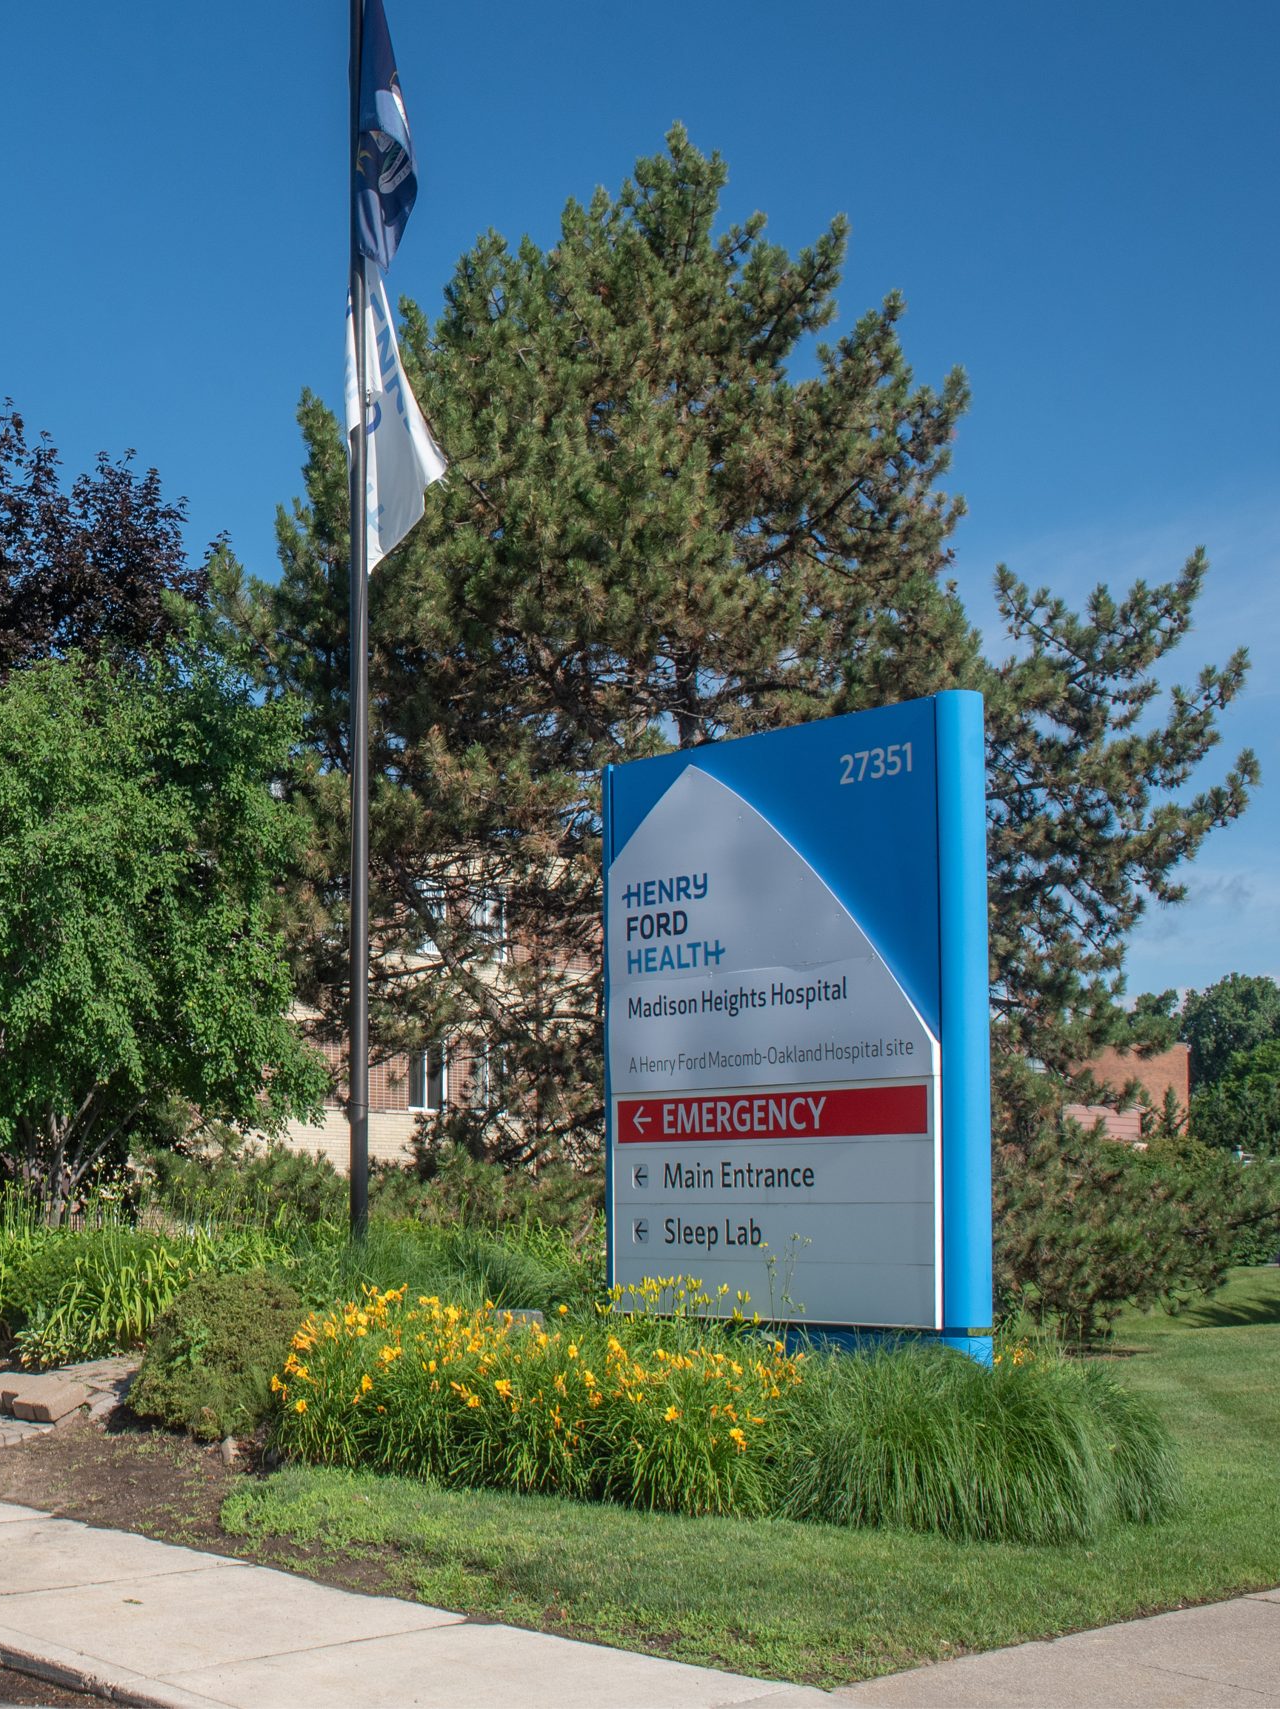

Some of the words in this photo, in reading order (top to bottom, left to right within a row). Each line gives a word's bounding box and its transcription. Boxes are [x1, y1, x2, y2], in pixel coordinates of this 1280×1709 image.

[840, 742, 913, 785] 27351
[622, 872, 709, 909] HENRY
[626, 910, 688, 941] FORD
[626, 939, 725, 975] HEALTH
[628, 994, 698, 1019] Madison
[702, 986, 766, 1017] Heights
[771, 976, 847, 1011] Hospital
[629, 1056, 638, 1074] A
[639, 1052, 676, 1075] Henry
[678, 1046, 707, 1071] Ford
[709, 1038, 822, 1068] Macomb-Oakland
[824, 1038, 883, 1064] Hospital
[886, 1038, 913, 1056] site
[662, 1096, 826, 1134] EMERGENCY
[664, 1162, 714, 1189] Main
[721, 1162, 815, 1188] Entrance
[664, 1218, 718, 1251] Sleep
[725, 1218, 762, 1246] Lab
